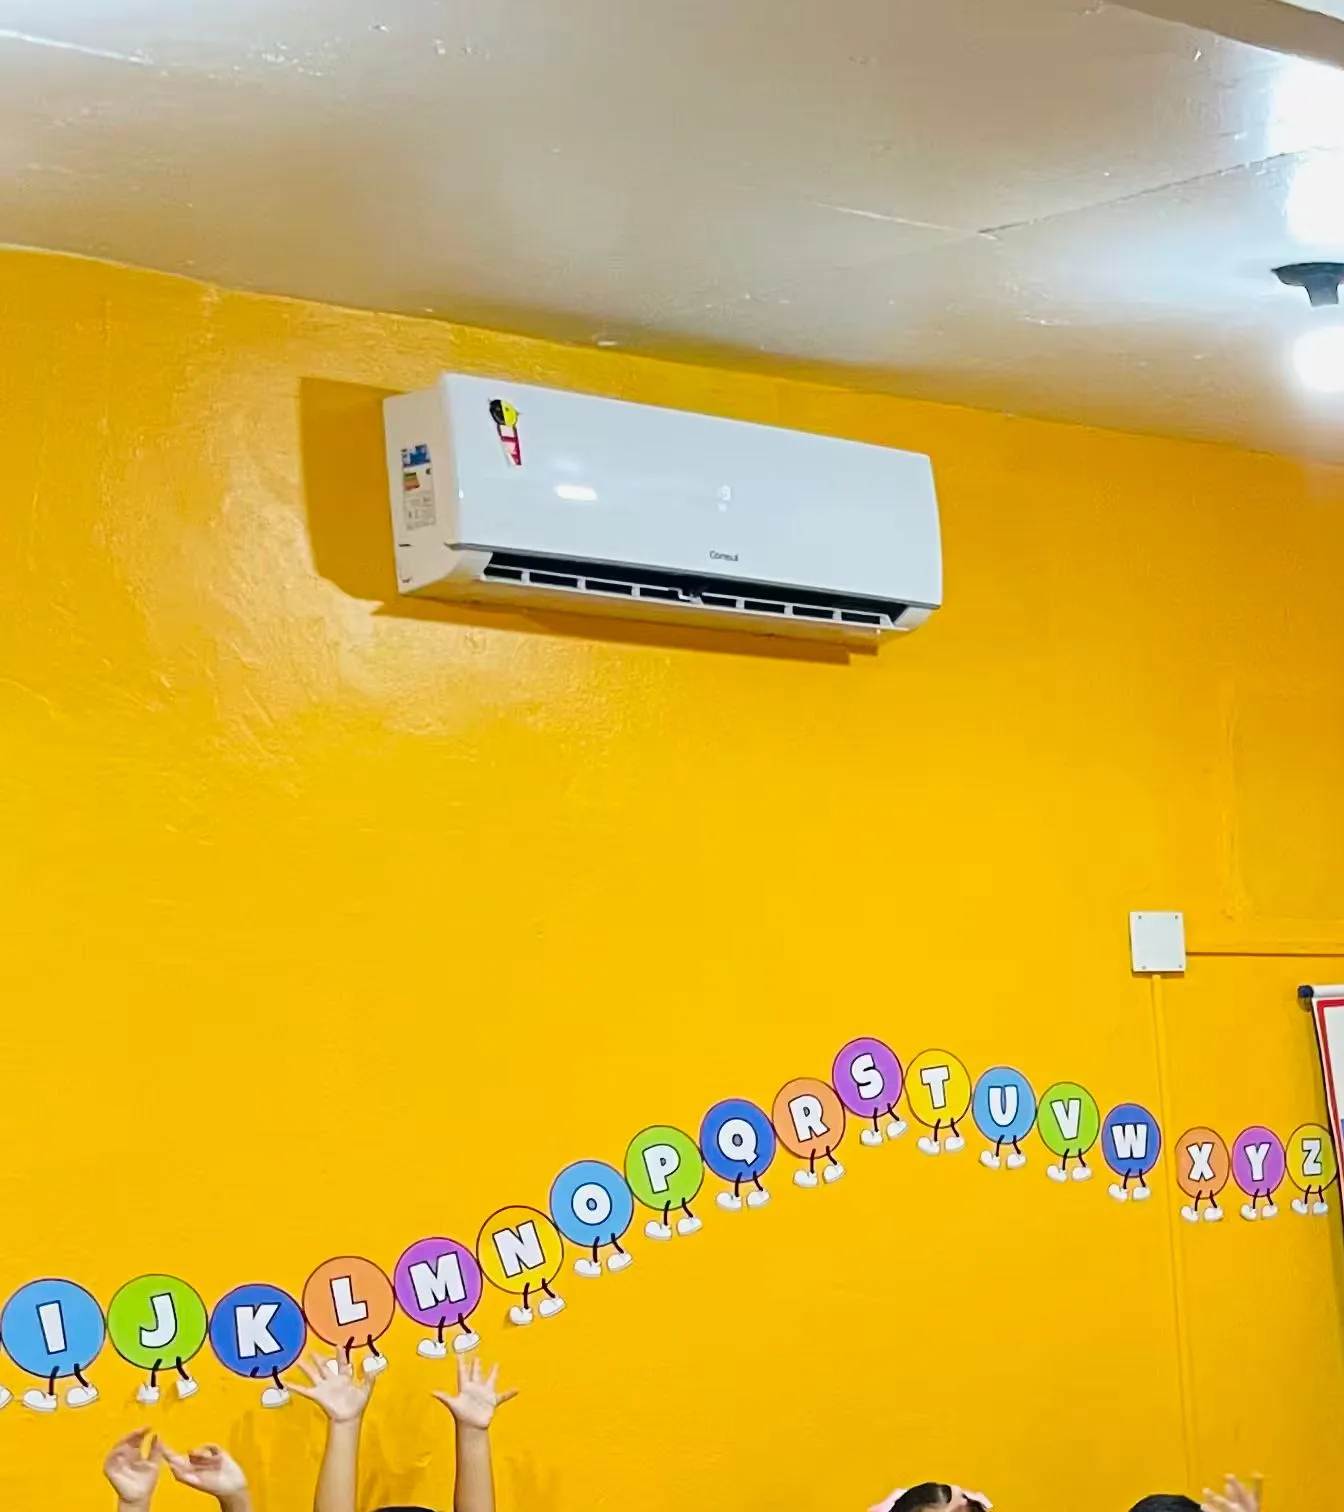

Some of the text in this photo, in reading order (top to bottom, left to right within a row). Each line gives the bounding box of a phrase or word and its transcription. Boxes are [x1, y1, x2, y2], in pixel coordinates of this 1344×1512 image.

[37, 1053, 1322, 1359] I J K L M N O P Q R S T U V W X Y Z
